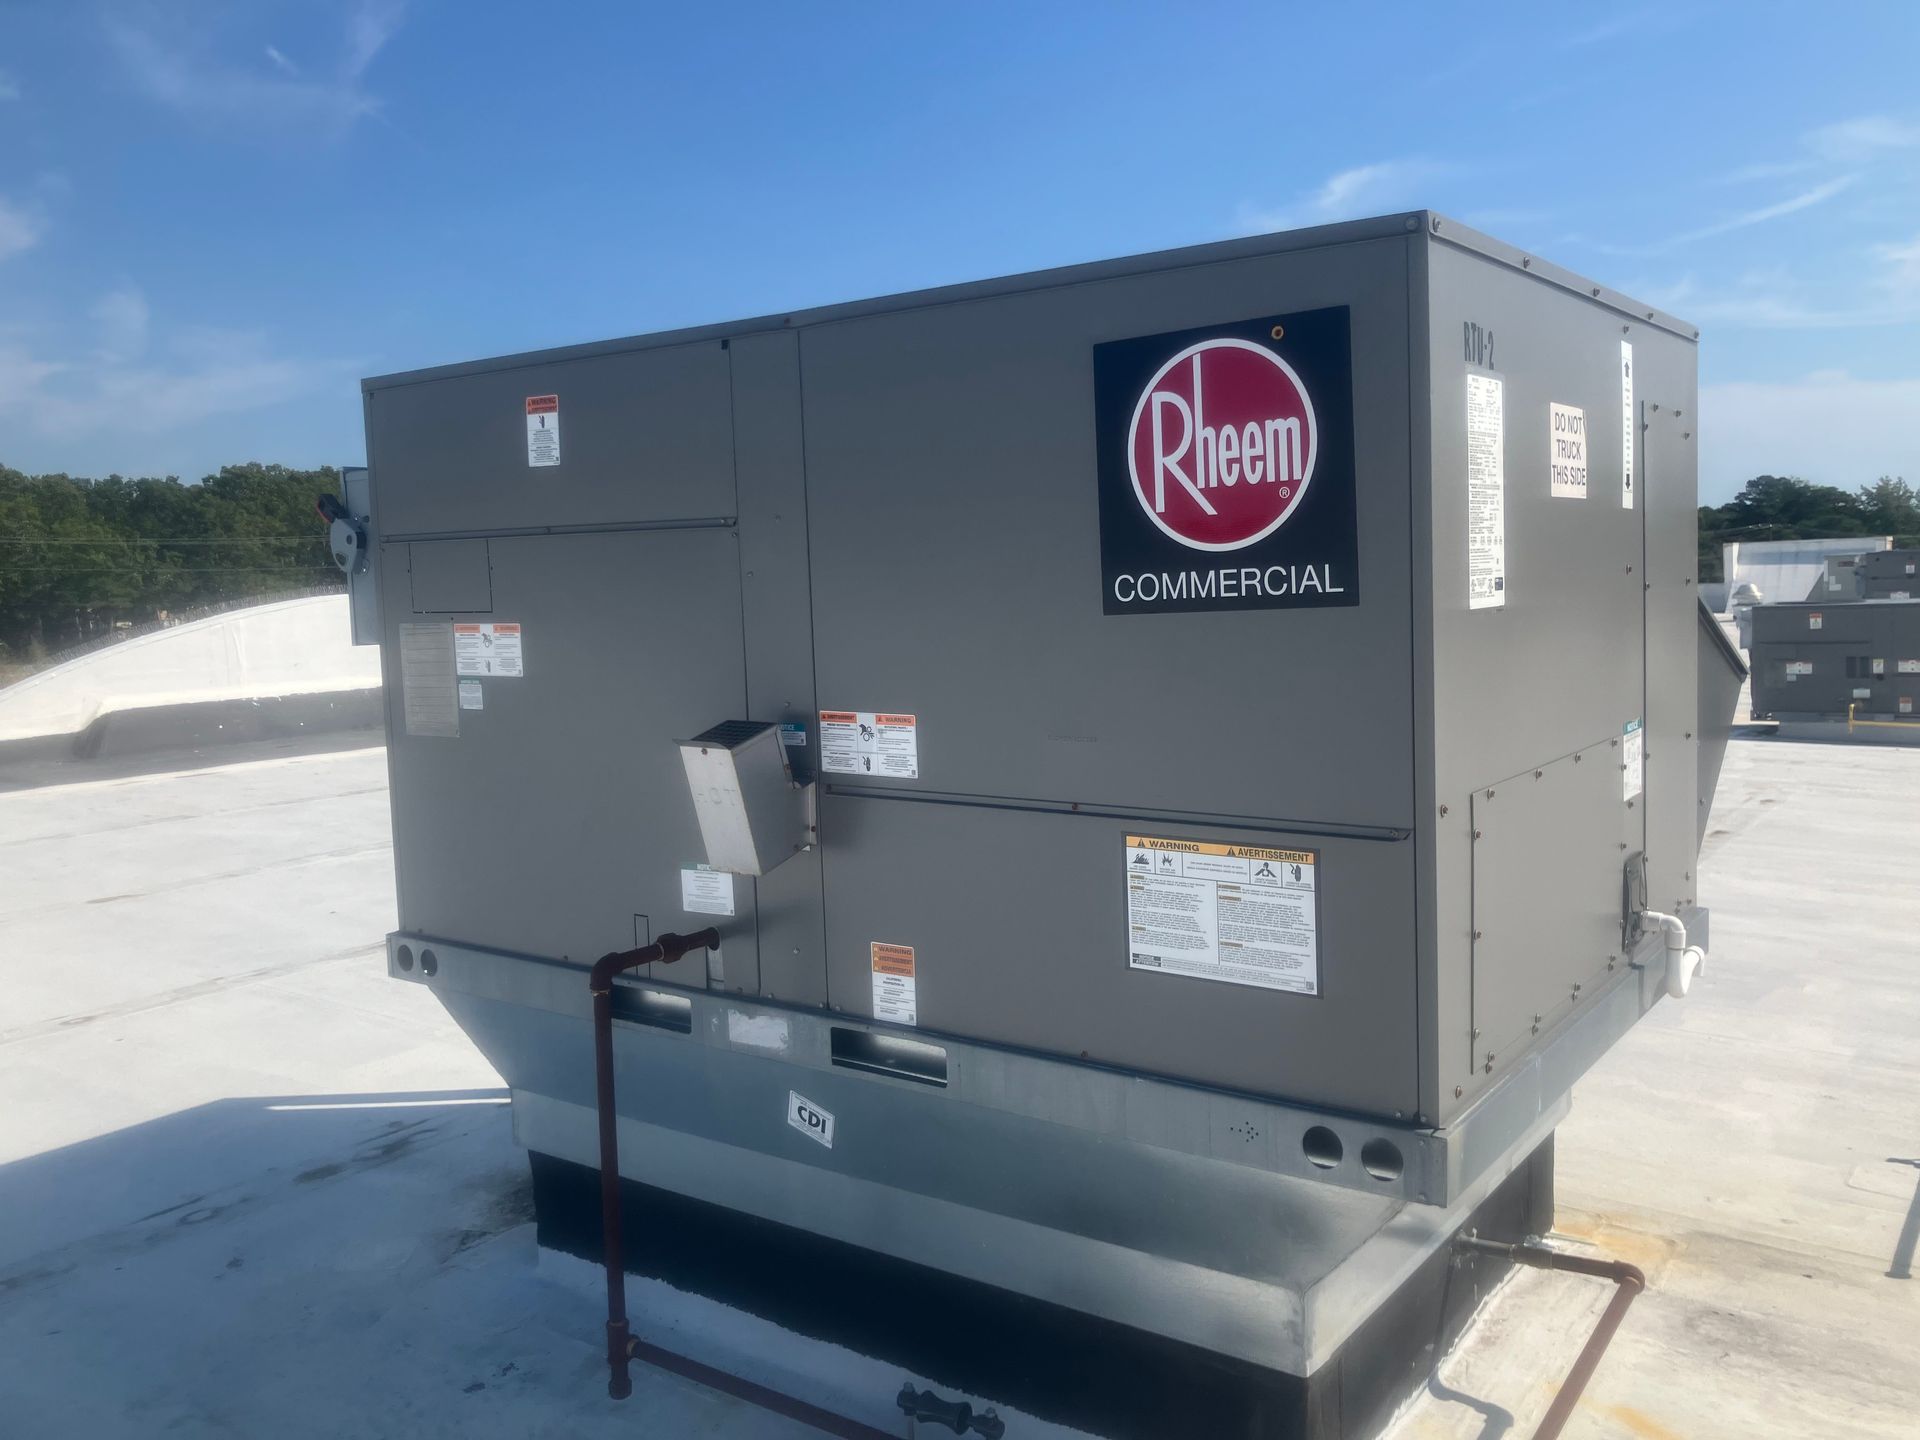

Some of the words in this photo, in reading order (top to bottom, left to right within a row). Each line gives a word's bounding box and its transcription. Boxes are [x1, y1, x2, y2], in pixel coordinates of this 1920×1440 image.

[1464, 321, 1494, 370] RTU-2
[1151, 352, 1303, 516] Rheem
[1554, 412, 1566, 432] DO
[1567, 415, 1583, 435] NOT
[1556, 439, 1582, 460] TRUCK
[1552, 464, 1569, 485] THIS
[1570, 466, 1586, 486] SIDE
[1114, 563, 1345, 603] COMMERCIAL
[1149, 839, 1200, 852] WARNING
[1238, 848, 1310, 863] AVERTISSEMENT
[797, 1105, 827, 1134] CDI
